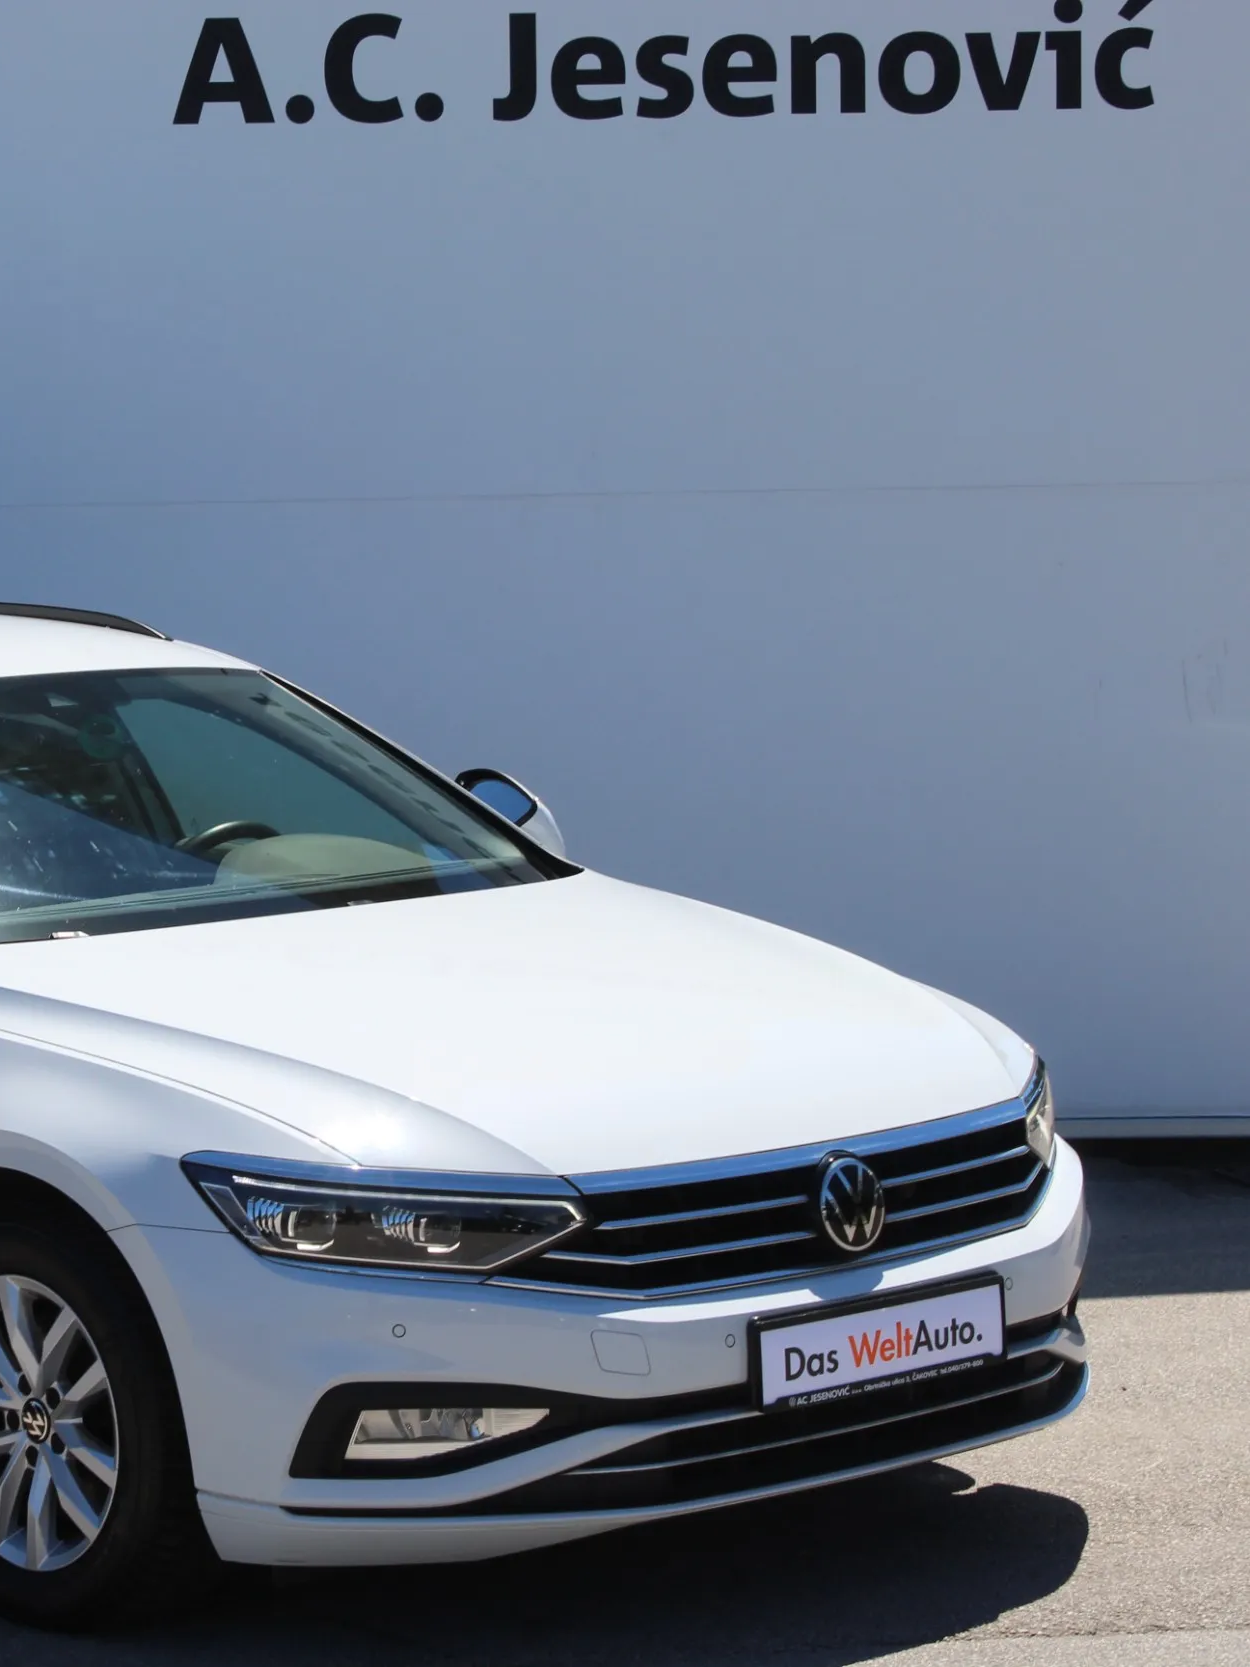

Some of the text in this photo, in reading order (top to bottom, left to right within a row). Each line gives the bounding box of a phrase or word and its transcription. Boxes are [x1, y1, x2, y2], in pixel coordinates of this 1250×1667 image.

[173, 0, 1155, 124] A.C. Jesenović
[784, 1318, 983, 1382] Das WeltAuto.
[810, 1385, 851, 1404] JESENOVIĆ
